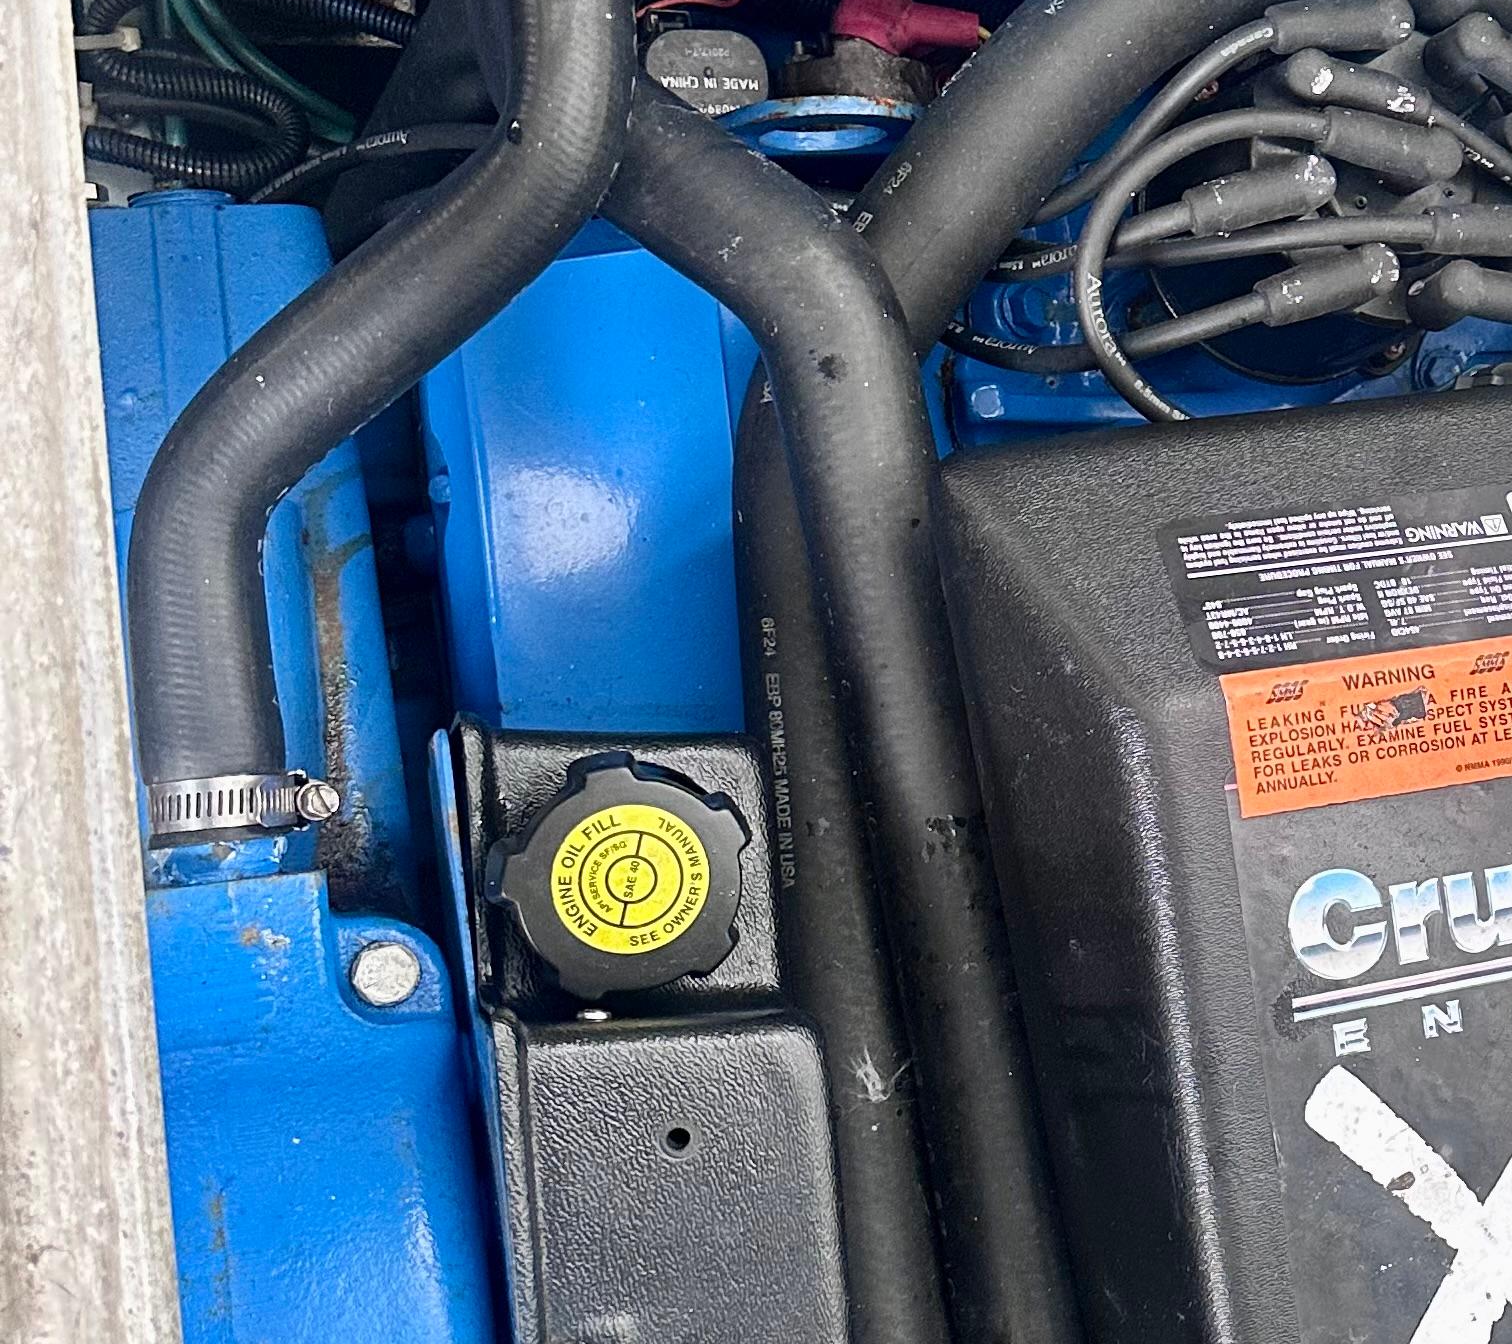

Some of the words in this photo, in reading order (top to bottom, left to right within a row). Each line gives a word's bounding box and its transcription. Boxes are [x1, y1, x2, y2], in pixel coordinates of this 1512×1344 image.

[660, 75, 700, 89] CHINA
[703, 76, 718, 89] IN
[722, 77, 759, 91] MADE
[852, 211, 873, 233] EB
[1403, 517, 1483, 544] WARNING
[1258, 567, 1310, 582] PROCEDURE
[765, 672, 782, 708] EBP
[1341, 662, 1436, 691] WARNING
[1246, 708, 1325, 731] LEAKING
[1425, 692, 1437, 705] A
[1449, 685, 1488, 702] FIRE
[1249, 722, 1336, 747] EXPLOSION
[1250, 736, 1349, 762] REGULARLY.
[1356, 725, 1426, 747] EXAMINE
[1433, 718, 1472, 735] FUEL
[1253, 762, 1285, 779] FOR
[1291, 754, 1342, 773] LEAKS
[1347, 749, 1370, 764] OR
[1376, 735, 1467, 759] CORROSION
[1470, 731, 1490, 745] AT
[1255, 770, 1338, 794] ANNUALLY.
[773, 777, 792, 830] MADE
[581, 814, 622, 841] FILL
[657, 816, 703, 868] MANUAL
[777, 832, 793, 851] IN
[561, 843, 586, 869] OIL
[629, 860, 641, 874] 40
[588, 860, 602, 900] SERVICE
[779, 854, 796, 890] USA
[623, 875, 638, 899] SAE
[558, 875, 599, 937] ENGINE
[662, 872, 703, 934] OWNER'S
[629, 929, 661, 947] SEE
